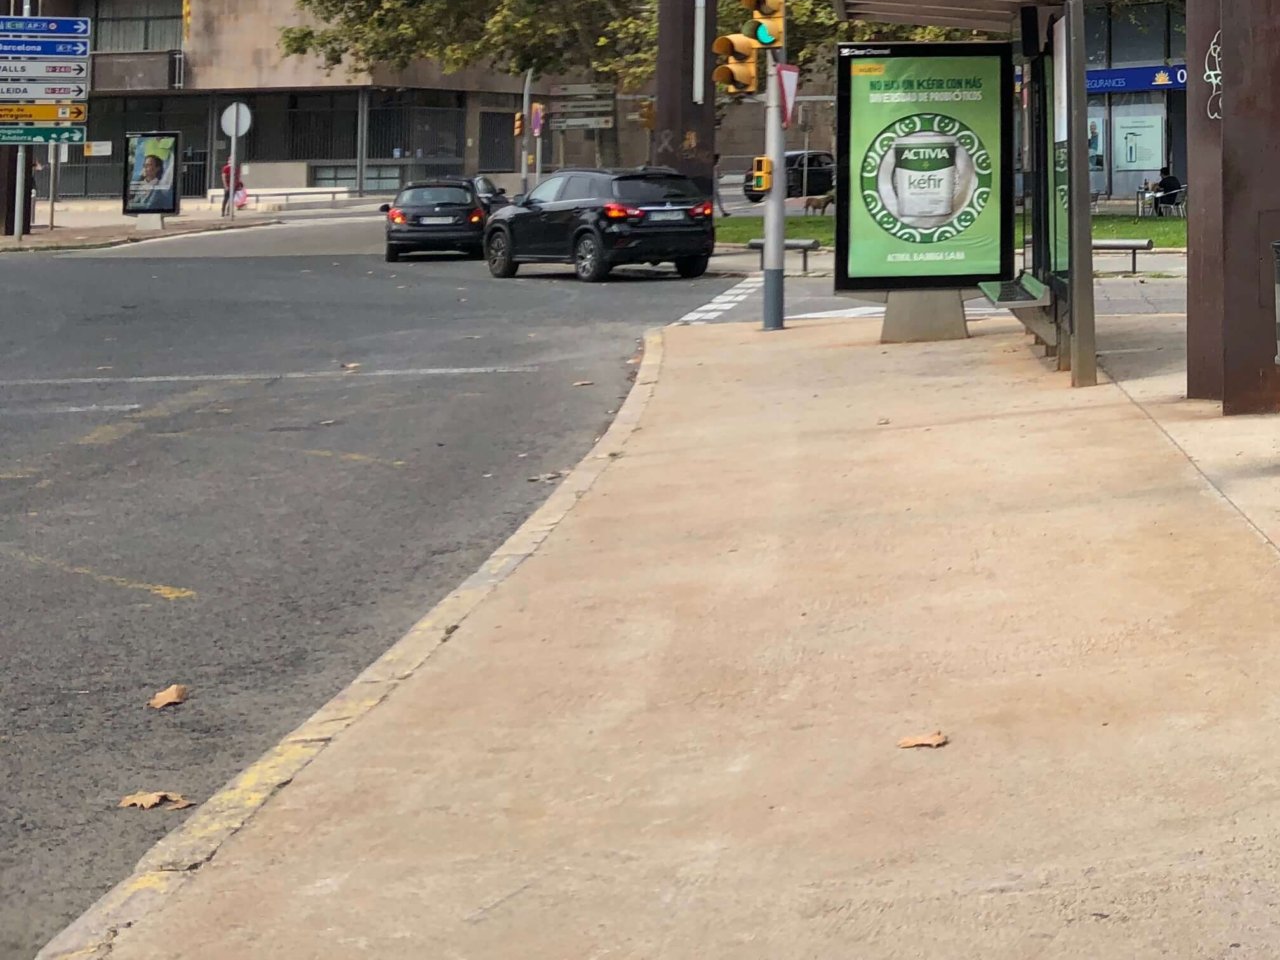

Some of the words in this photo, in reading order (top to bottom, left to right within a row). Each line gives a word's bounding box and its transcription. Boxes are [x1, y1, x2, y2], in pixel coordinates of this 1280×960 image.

[869, 80, 882, 90] NO
[916, 76, 945, 90] KÉFIR
[946, 78, 963, 89] CON
[963, 76, 983, 89] MÁS
[1086, 77, 1127, 89] EGURANCES
[918, 91, 929, 102] DE
[901, 147, 950, 160] ACTIVIA
[908, 174, 944, 190] kéfir
